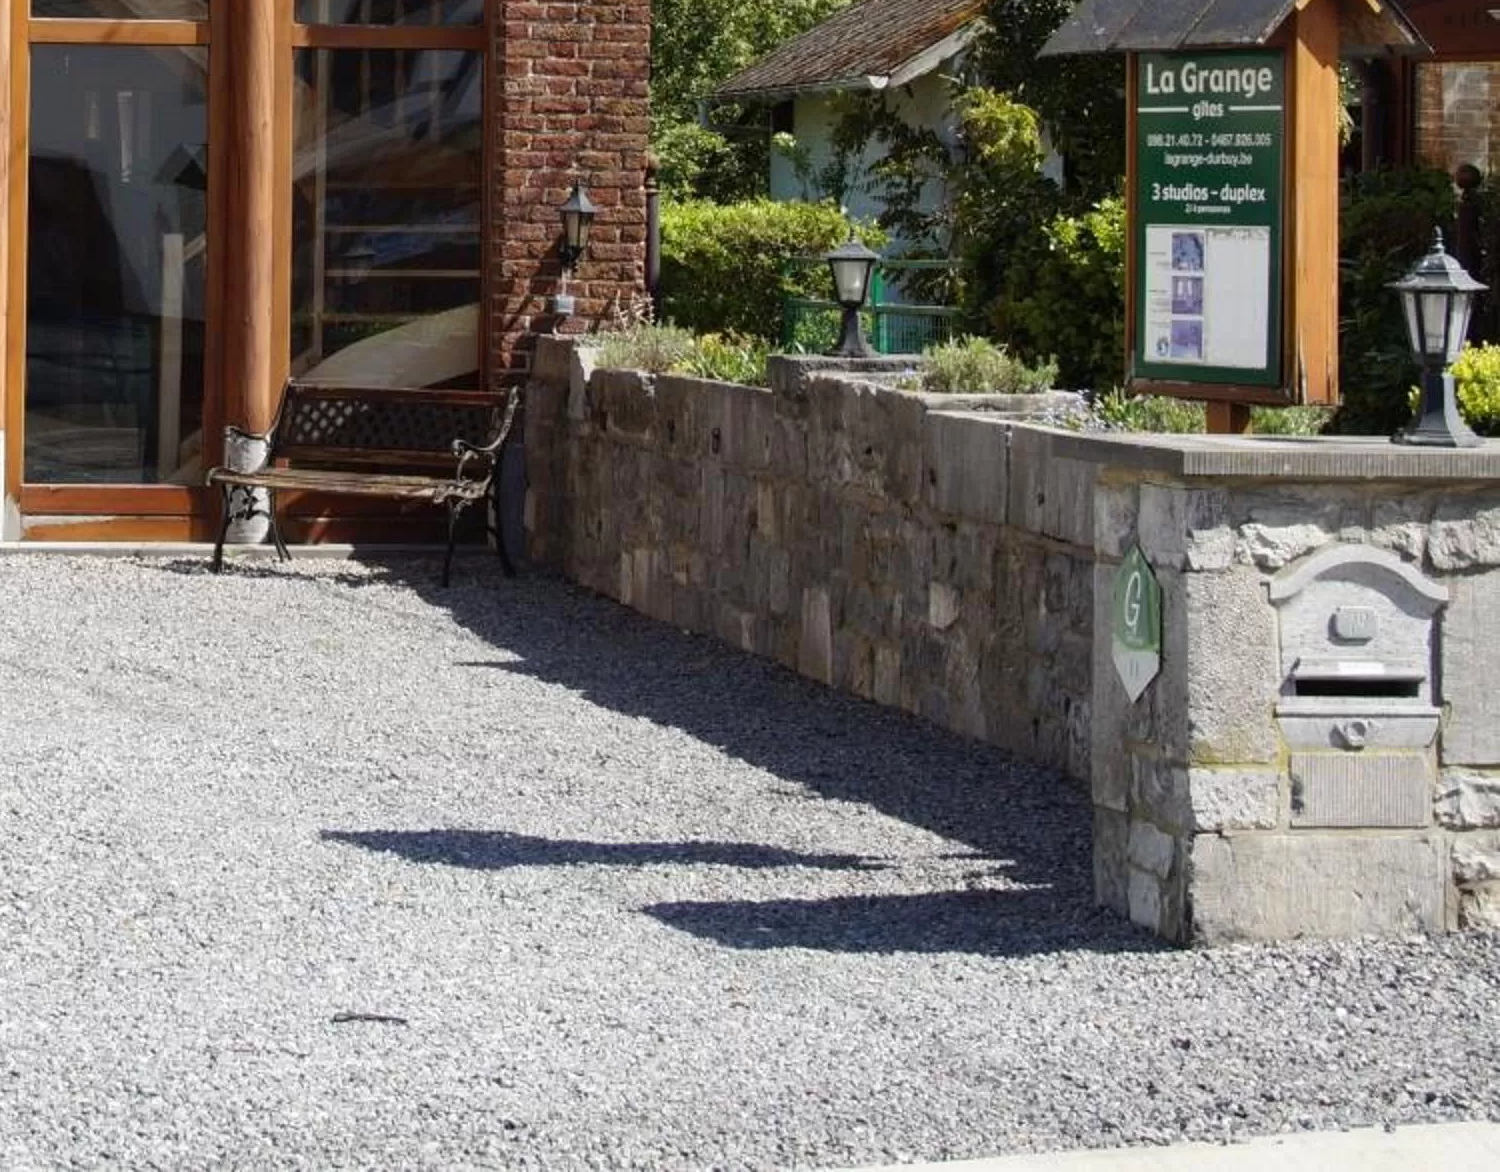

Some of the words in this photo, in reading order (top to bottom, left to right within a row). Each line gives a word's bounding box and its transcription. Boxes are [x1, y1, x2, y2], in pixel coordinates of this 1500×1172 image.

[1147, 63, 1175, 94] La
[1180, 61, 1273, 98] Grange
[1152, 182, 1161, 201] 3
[1162, 182, 1208, 201] studios
[1219, 183, 1266, 204] duplex
